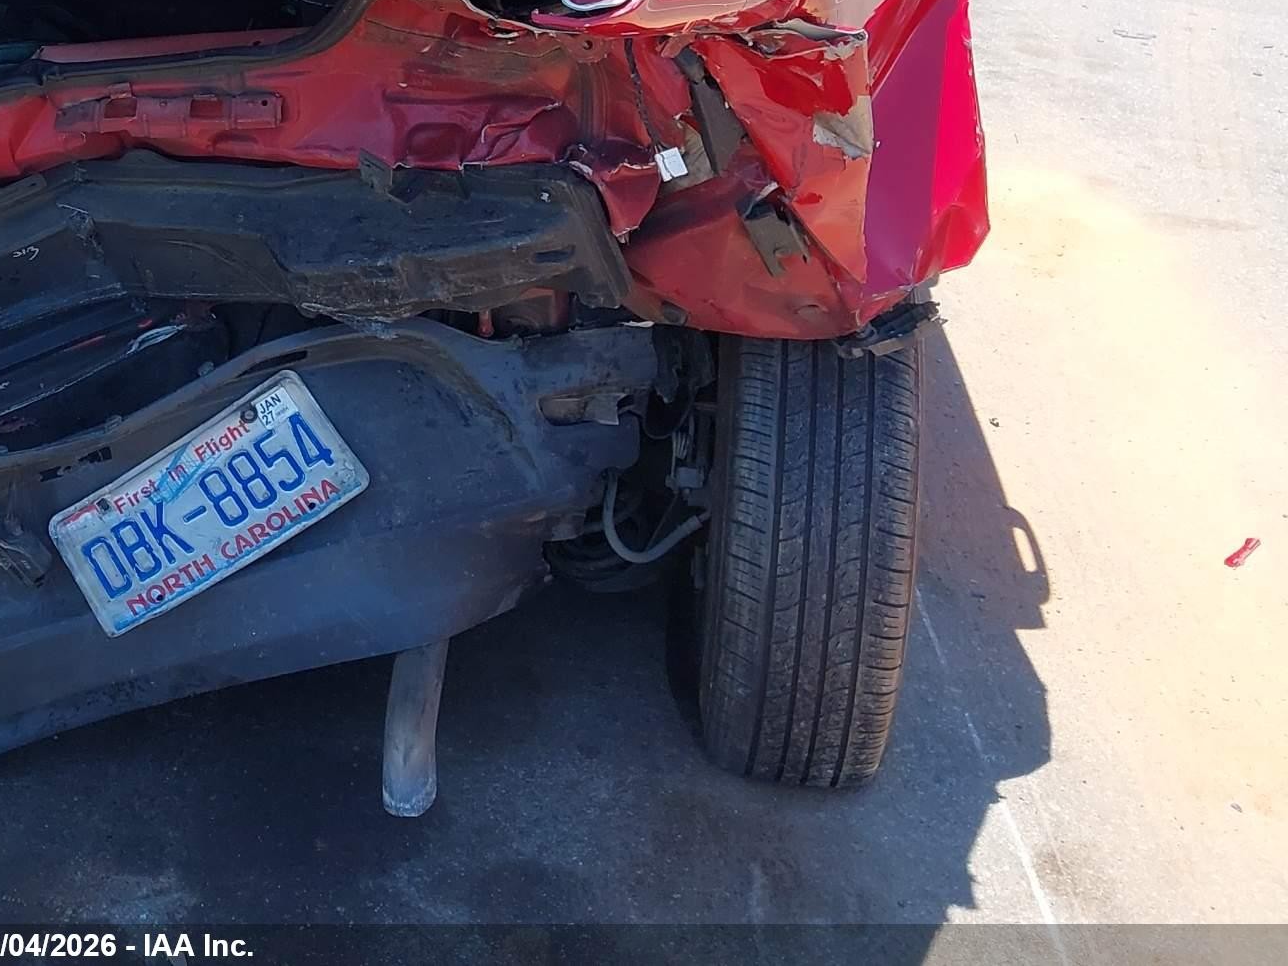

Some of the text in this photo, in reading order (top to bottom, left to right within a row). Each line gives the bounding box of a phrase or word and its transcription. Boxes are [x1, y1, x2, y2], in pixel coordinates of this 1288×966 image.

[259, 393, 282, 414] JAN
[262, 410, 275, 426] 27
[81, 411, 334, 601] DBK-8854
[113, 479, 159, 514] First
[194, 418, 250, 463] Flight
[126, 478, 341, 616] NORTH CAROLINA
